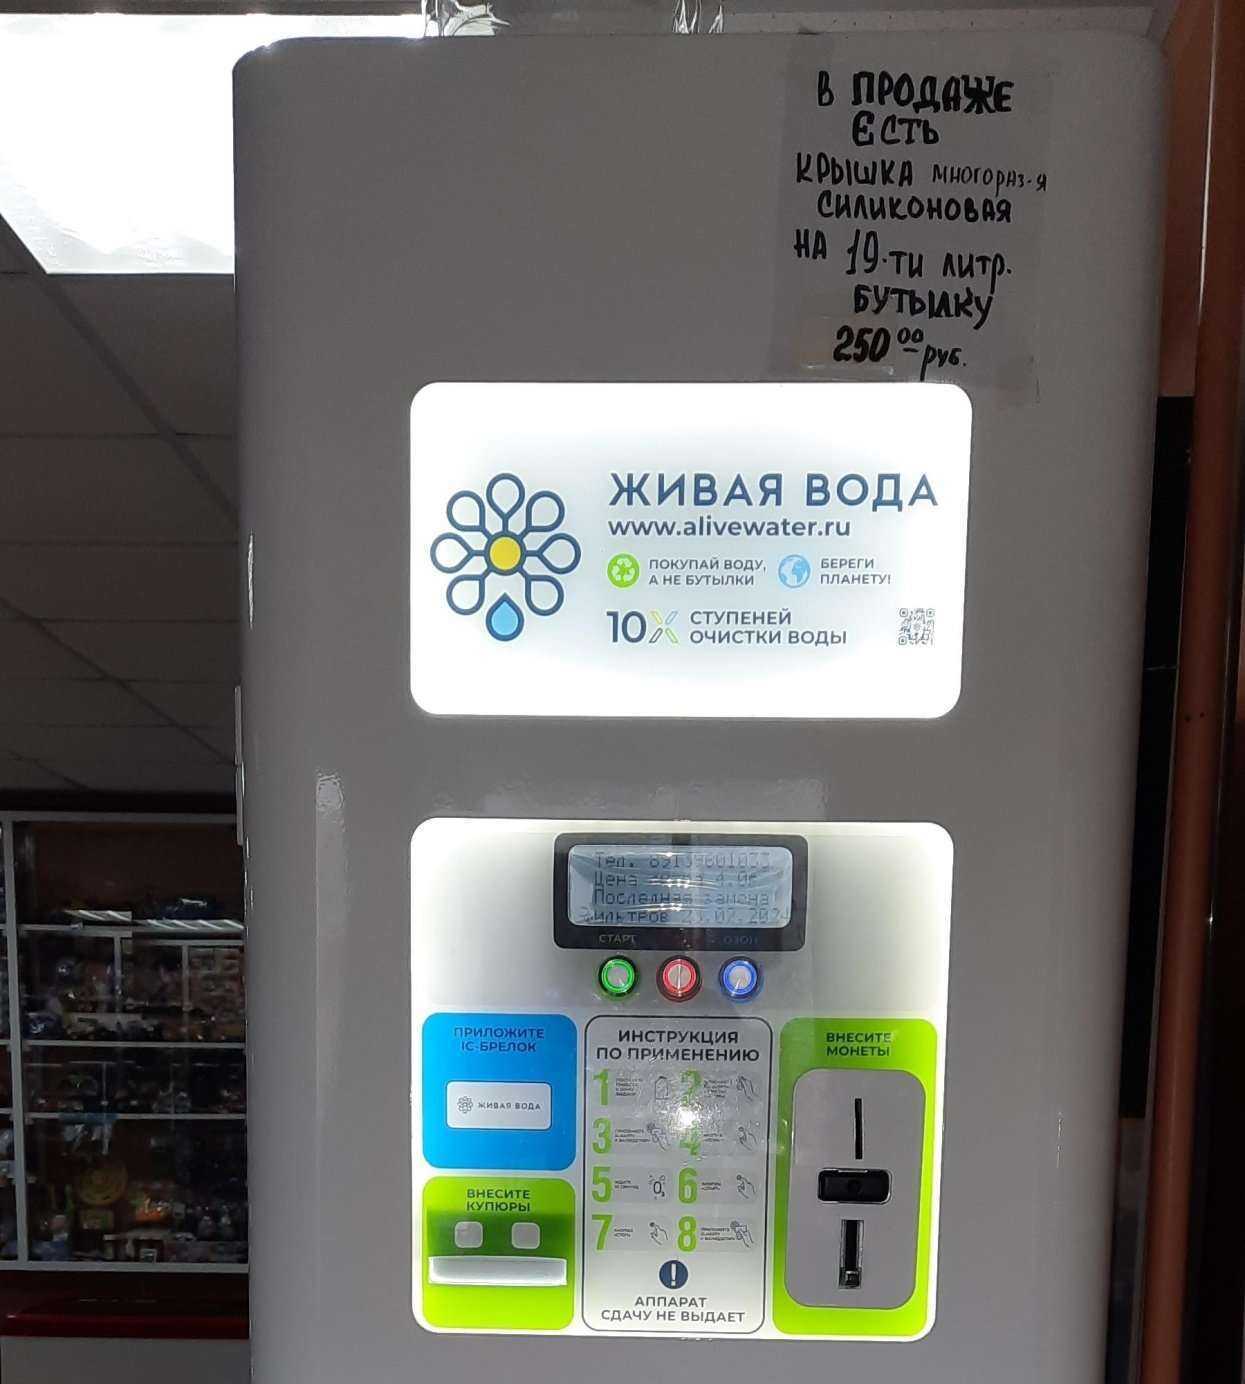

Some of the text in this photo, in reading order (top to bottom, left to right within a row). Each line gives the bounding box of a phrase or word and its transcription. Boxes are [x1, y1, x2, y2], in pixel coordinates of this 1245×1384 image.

[818, 71, 1014, 114] В ПРОДАЖЕ
[852, 111, 939, 146] ЕСТЬ
[796, 152, 913, 186] КРЫШКА
[817, 190, 1011, 222] СИЛИКОНОВАЯ
[793, 229, 827, 259] НА
[854, 284, 993, 330] БУТЫЛКУ
[833, 325, 891, 362] 250
[608, 473, 938, 512] ЖИВАЯ ВОДА
[608, 516, 851, 538] www.alivewater.ru
[649, 556, 767, 573] ПОКУПАЙ ВОДУ,
[820, 558, 874, 570] БЕРЕГИ
[648, 574, 755, 587] А НЕ БУТЫЛКИ
[820, 573, 891, 585] ПЛАНЕТУ!
[690, 607, 791, 625] СТУПЕНЕЙ
[690, 629, 847, 647] ОЧИСТКИ ВОДЫ
[454, 1027, 545, 1039] ПРИЛОЖИТЕ
[618, 1030, 739, 1045] ИНСТРУКЦИЯ
[826, 1032, 893, 1044] ВНЕСИТЕ
[597, 1048, 760, 1063] ПО ПРИМЕНЕНИЮ
[826, 1045, 891, 1057] МОНЕТЫ
[592, 1068, 609, 1106] 1
[478, 1101, 541, 1111] ЖИВАЯ ВОДА
[592, 1117, 613, 1154] 3
[592, 1167, 612, 1202] 5
[679, 1168, 698, 1204] 6
[467, 1188, 531, 1200] ВНЕСИТЕ
[467, 1201, 531, 1213] КУПЮРЫ
[592, 1214, 613, 1251] 7
[678, 1216, 697, 1252] 8
[634, 1296, 708, 1309] АППАРАТ
[601, 1310, 746, 1324] СДАЧУ НЕ ВЫДАЕТ
